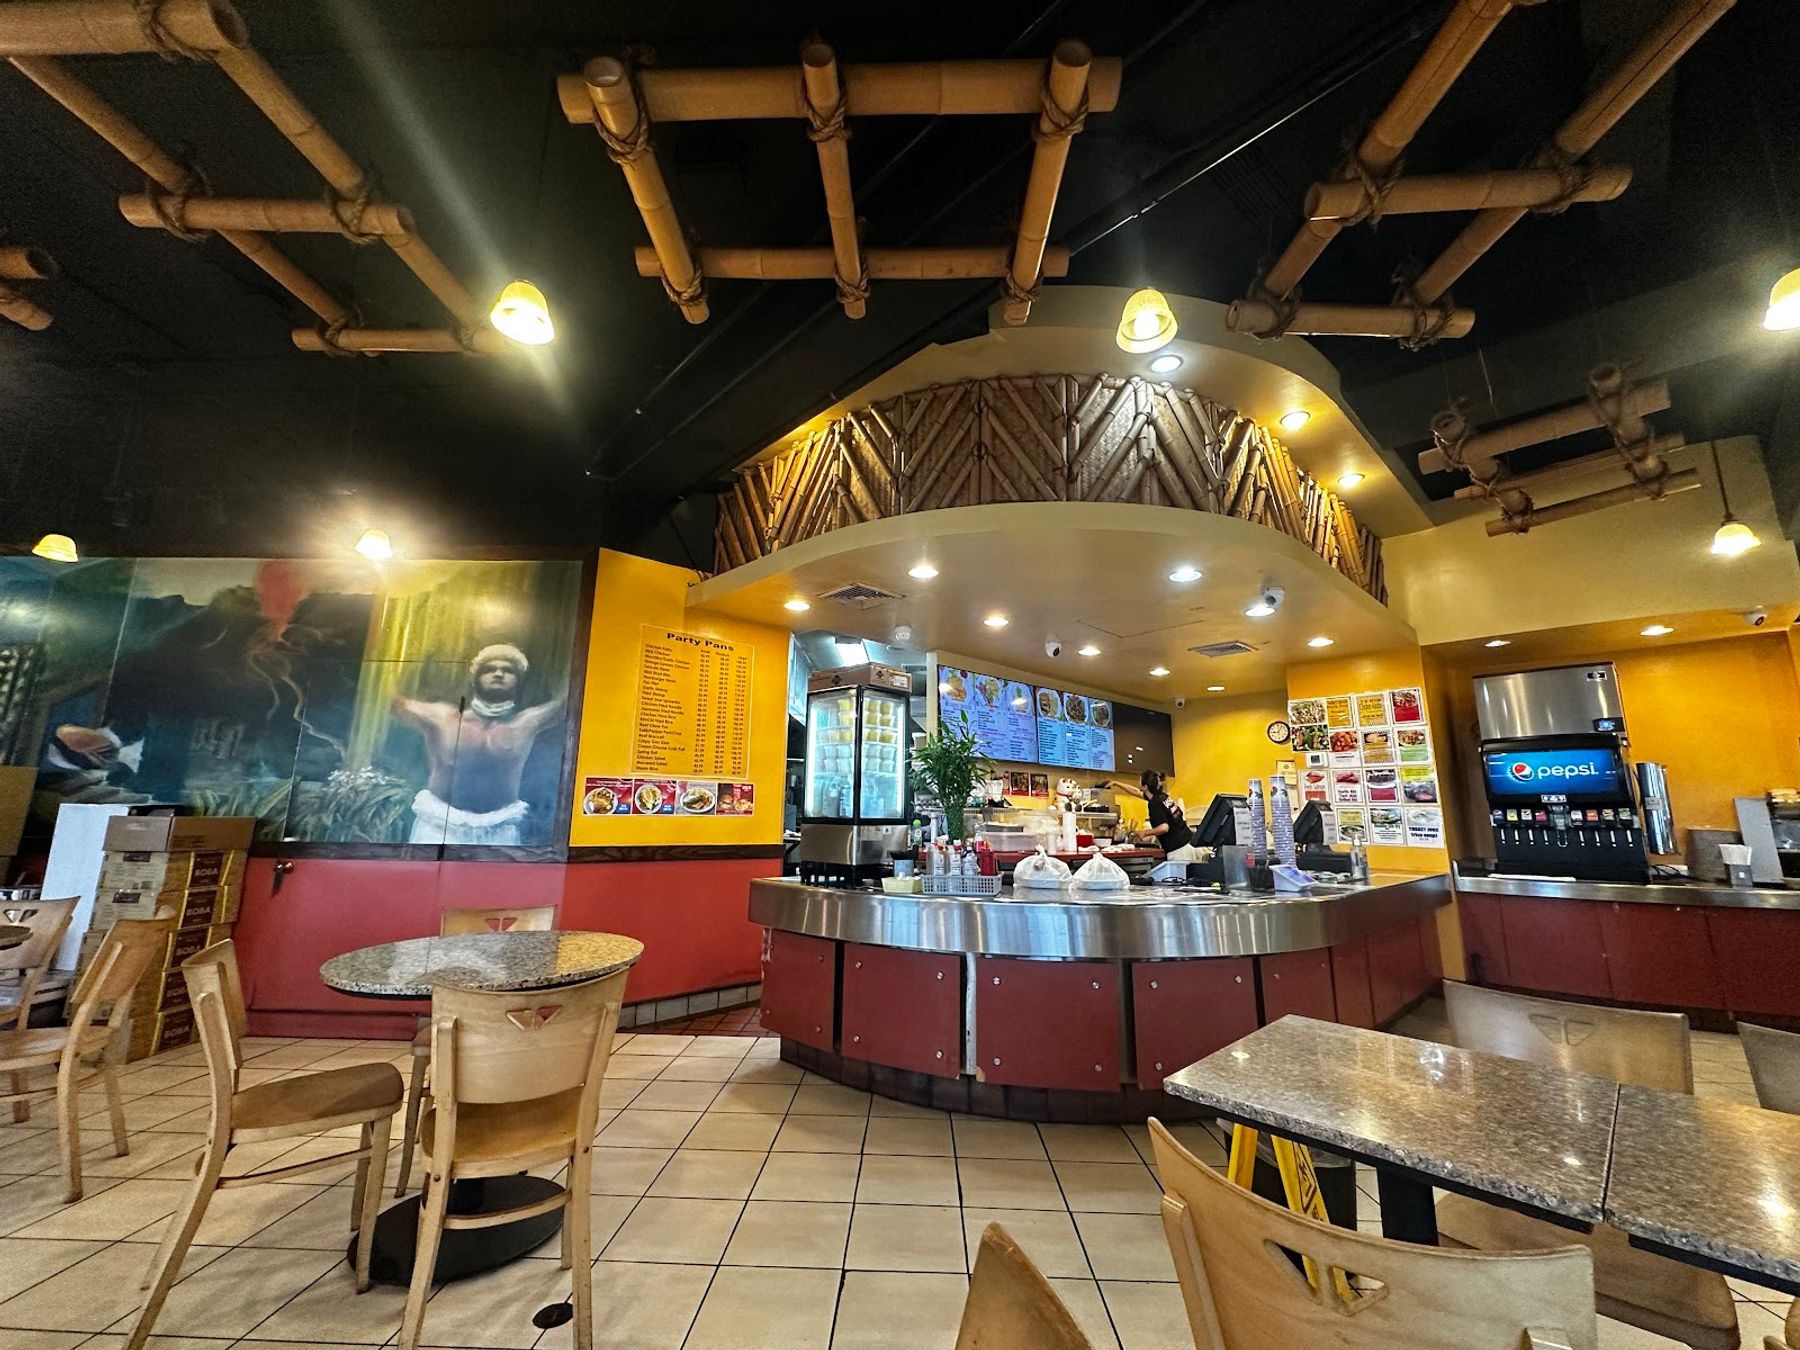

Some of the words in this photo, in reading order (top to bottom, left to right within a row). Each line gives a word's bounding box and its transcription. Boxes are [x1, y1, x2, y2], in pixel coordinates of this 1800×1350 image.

[667, 632, 701, 646] Party
[705, 640, 734, 651] Pans
[1537, 761, 1597, 779] pepsi
[194, 867, 219, 877] BOBA
[185, 906, 211, 916] BOBA
[164, 1025, 191, 1039] BOBA
